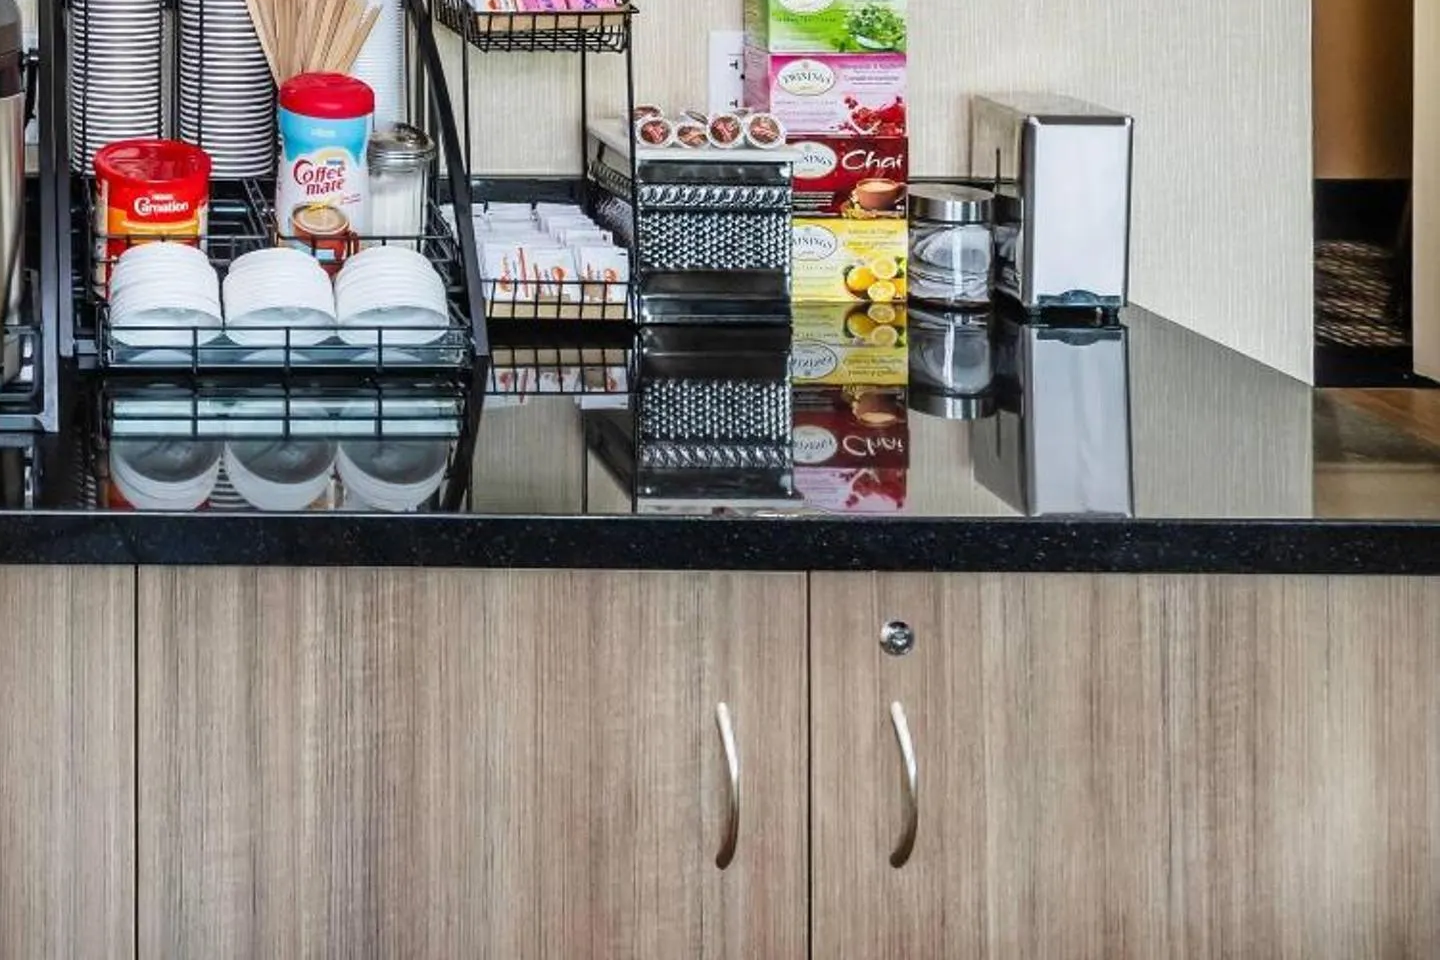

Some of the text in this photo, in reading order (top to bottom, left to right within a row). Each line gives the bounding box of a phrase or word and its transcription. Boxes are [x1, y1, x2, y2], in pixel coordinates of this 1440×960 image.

[841, 149, 903, 171] Chai
[293, 158, 346, 185] Coffee
[306, 179, 345, 196] mate
